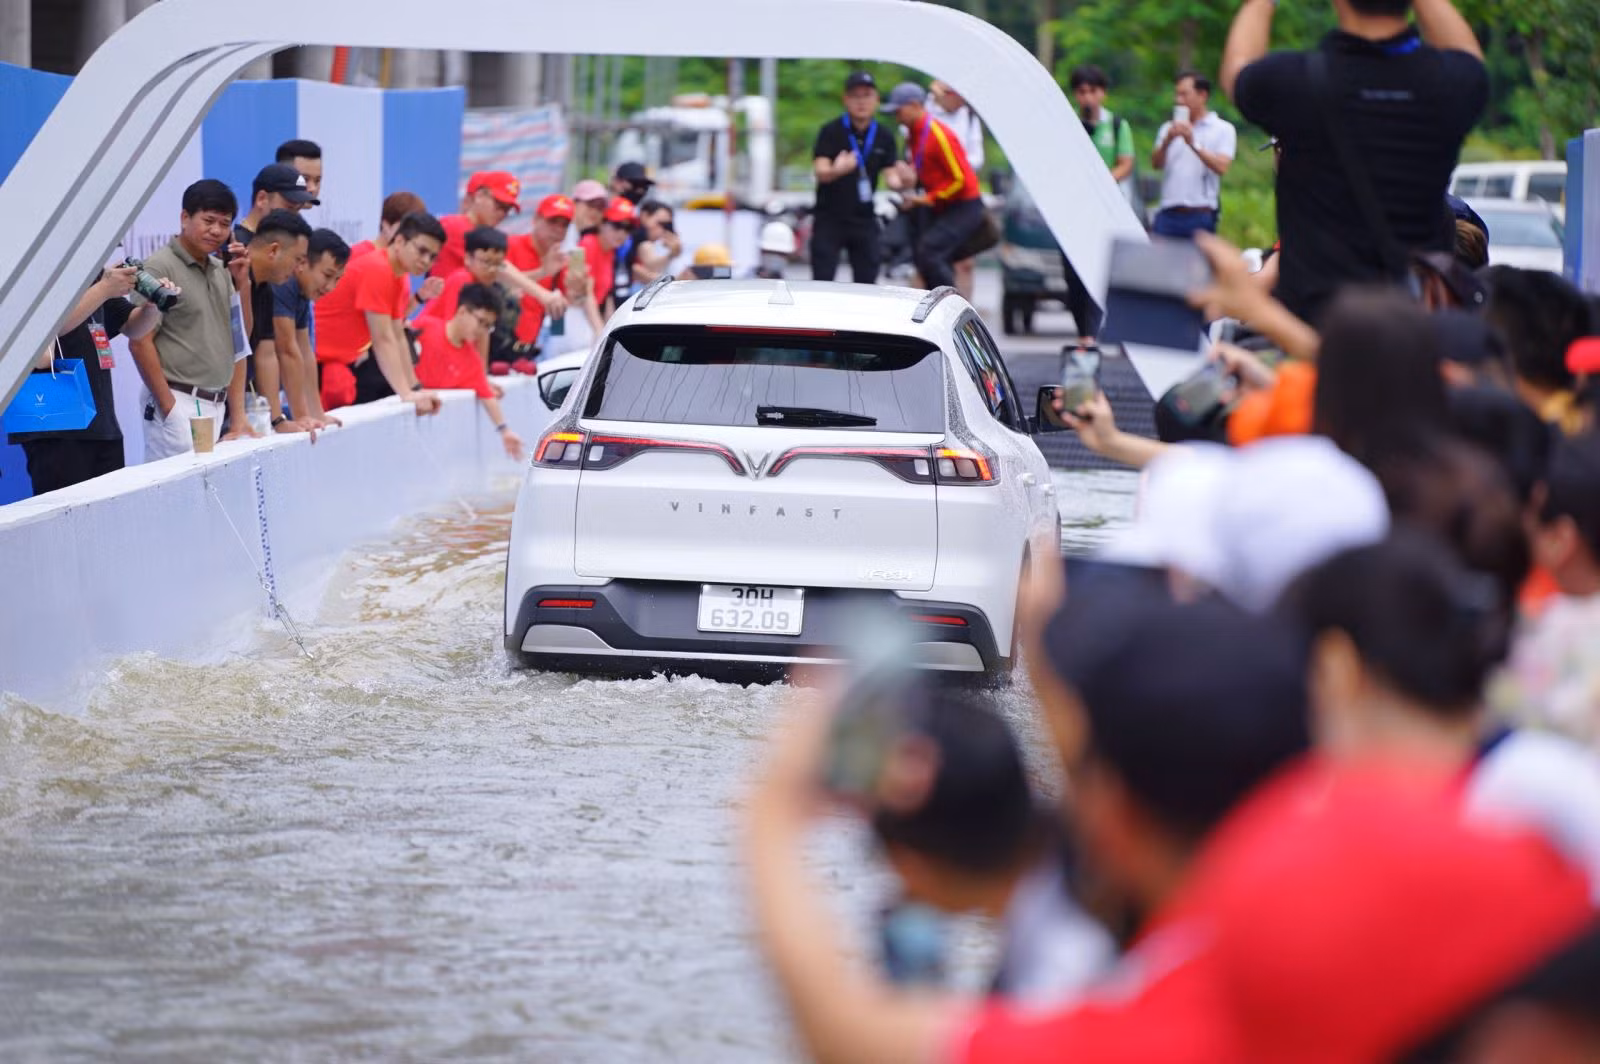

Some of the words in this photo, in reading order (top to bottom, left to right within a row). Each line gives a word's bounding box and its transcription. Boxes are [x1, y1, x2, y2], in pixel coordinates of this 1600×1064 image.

[670, 501, 842, 519] VINFAST
[730, 587, 774, 608] 30H
[710, 608, 790, 630] 632.09
